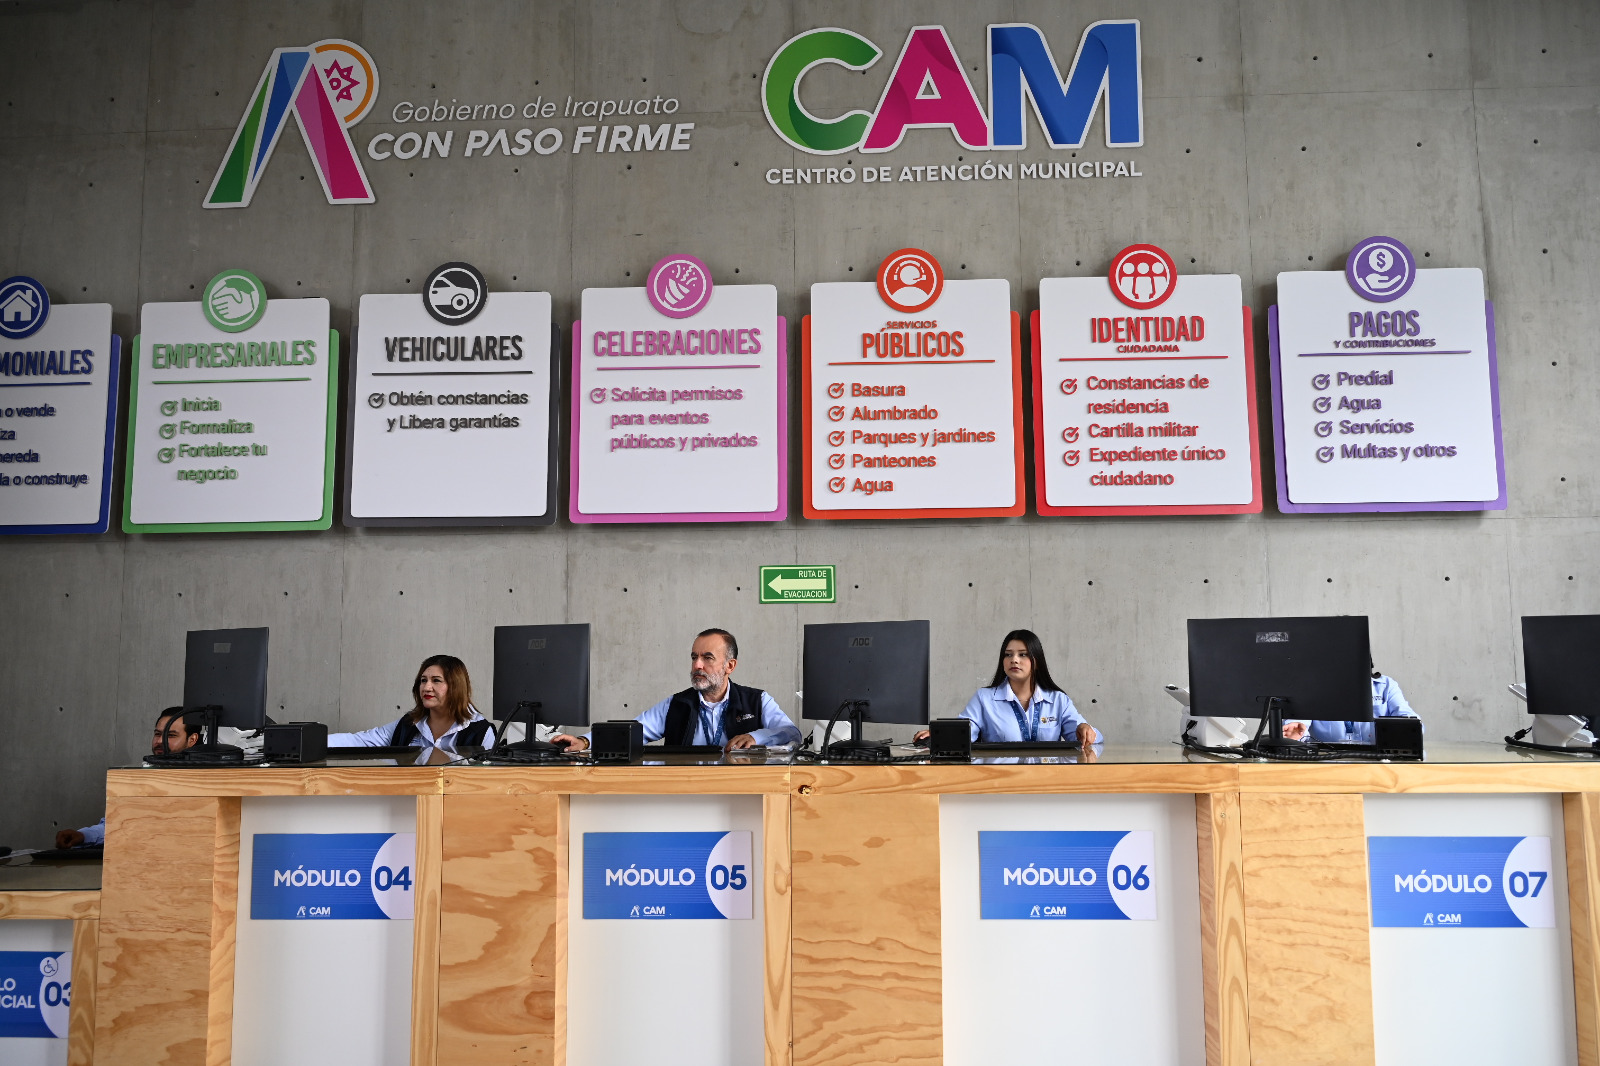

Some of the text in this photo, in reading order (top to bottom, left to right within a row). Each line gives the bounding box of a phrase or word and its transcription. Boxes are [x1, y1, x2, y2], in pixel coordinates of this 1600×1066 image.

[761, 19, 1143, 155] CAM
[392, 95, 680, 123] Gobierno de Irapuato
[367, 123, 695, 160] CON PASO FIRME
[766, 160, 1143, 185] CENTRO DE ATENCIÓN MUNICIPAL
[886, 320, 938, 330] SERVICIOS
[1091, 315, 1205, 343] IDENTIDAD
[1349, 310, 1421, 338] PAGOS
[384, 335, 523, 363] VEHICULARES
[593, 328, 762, 357] CELEBRACIONES
[861, 327, 965, 359] PÚBLICOS
[1117, 344, 1180, 353] CIUDADANA
[1334, 338, 1437, 349] Y CONTRIBUCIONES
[152, 340, 317, 370] EMPRESARIALES
[1086, 374, 1209, 390] Constancias de
[1337, 370, 1394, 387] Predial
[388, 389, 529, 407] Obtén constancias
[610, 386, 743, 405] Solicita permisos
[851, 382, 906, 397] Basura
[5, 407, 14, 417] o
[16, 403, 56, 417] vende
[181, 397, 221, 413] Inicia
[851, 405, 938, 421] Alumbrado
[1087, 399, 1169, 414] residencia
[1338, 397, 1382, 413] Agua
[179, 419, 254, 436] Formaliza
[387, 413, 520, 433] y Libera garantías
[610, 410, 710, 429] para eventos
[1339, 419, 1415, 435] Servicios
[852, 428, 996, 447] Parques y jardines
[1088, 422, 1199, 438] Cartilla militar
[610, 432, 758, 452] públicos y privados
[178, 443, 267, 459] Fortalece tu
[1089, 445, 1226, 465] Expediente único
[1341, 443, 1457, 461] Multas y otros
[852, 454, 937, 468] Panteones
[13, 475, 22, 486] o
[24, 473, 88, 488] construye
[177, 466, 238, 484] negocio
[1090, 471, 1174, 486] ciudadano
[852, 478, 894, 495] Agua
[798, 570, 816, 578] RUTA
[852, 637, 870, 647] AOC
[274, 865, 412, 892] MÓDULO 04
[605, 864, 747, 890] MÓDULO 05
[1003, 863, 1150, 891] MÓDULO 06
[1394, 869, 1548, 897] MÓDULO 07
[309, 906, 331, 915] CAM
[643, 906, 665, 915] CAM
[1043, 906, 1066, 915] CAM
[1437, 913, 1461, 923] CAM
